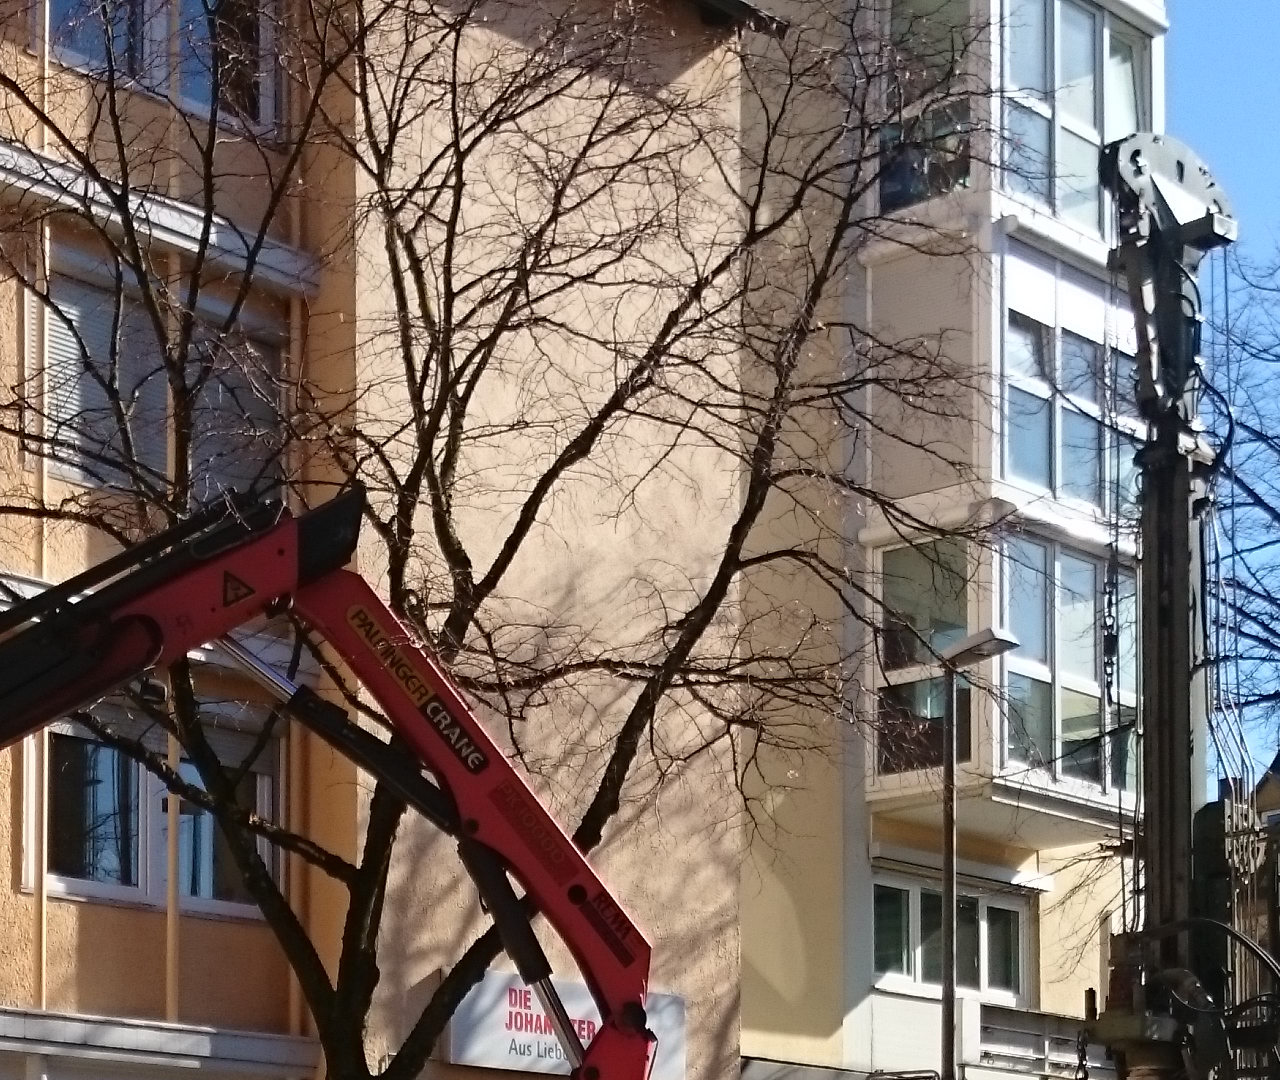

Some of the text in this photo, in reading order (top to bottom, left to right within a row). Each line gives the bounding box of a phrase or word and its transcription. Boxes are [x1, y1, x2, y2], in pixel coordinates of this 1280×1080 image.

[350, 609, 484, 769] PALFINGER CRANE
[508, 988, 532, 1010] DIE
[505, 1011, 596, 1041] JOHANTER
[508, 1038, 532, 1056] Aus
